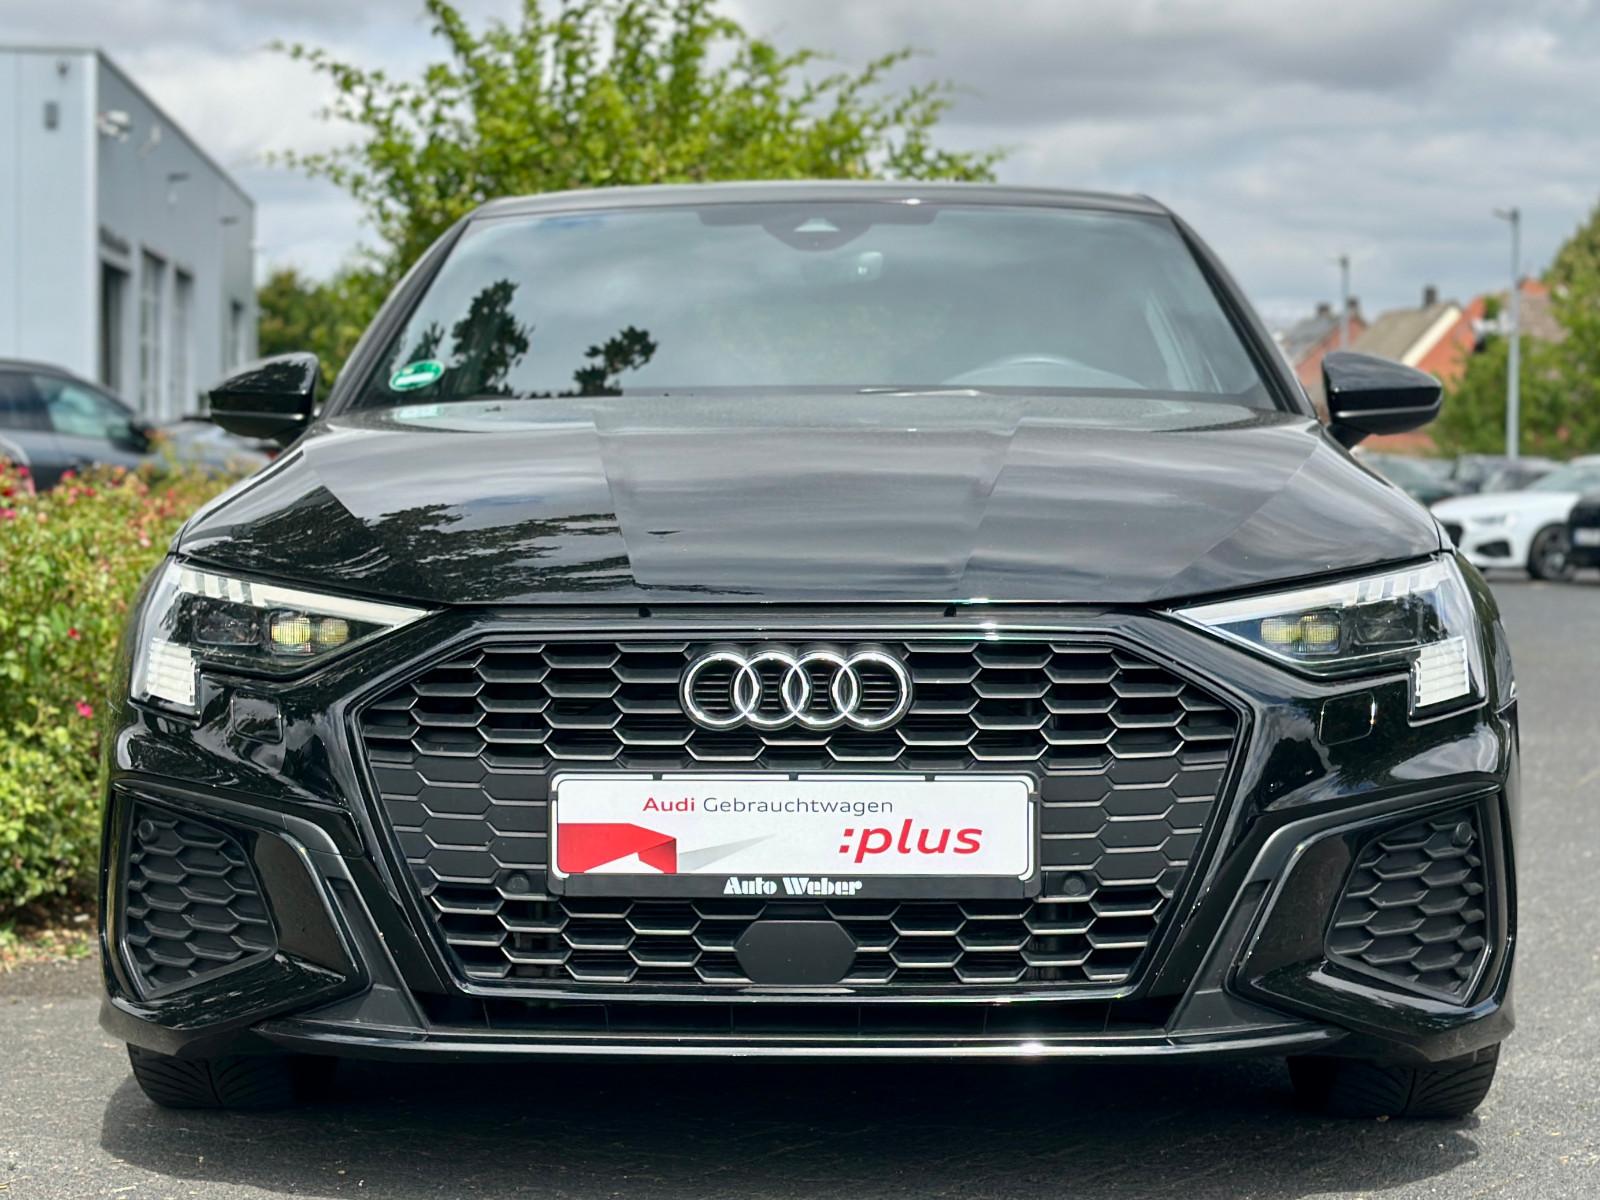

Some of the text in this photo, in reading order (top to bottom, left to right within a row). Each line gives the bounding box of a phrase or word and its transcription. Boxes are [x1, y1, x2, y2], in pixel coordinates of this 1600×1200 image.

[642, 797, 893, 816] Audi Gebrauchtwagen
[723, 876, 863, 896] Auto Weber
